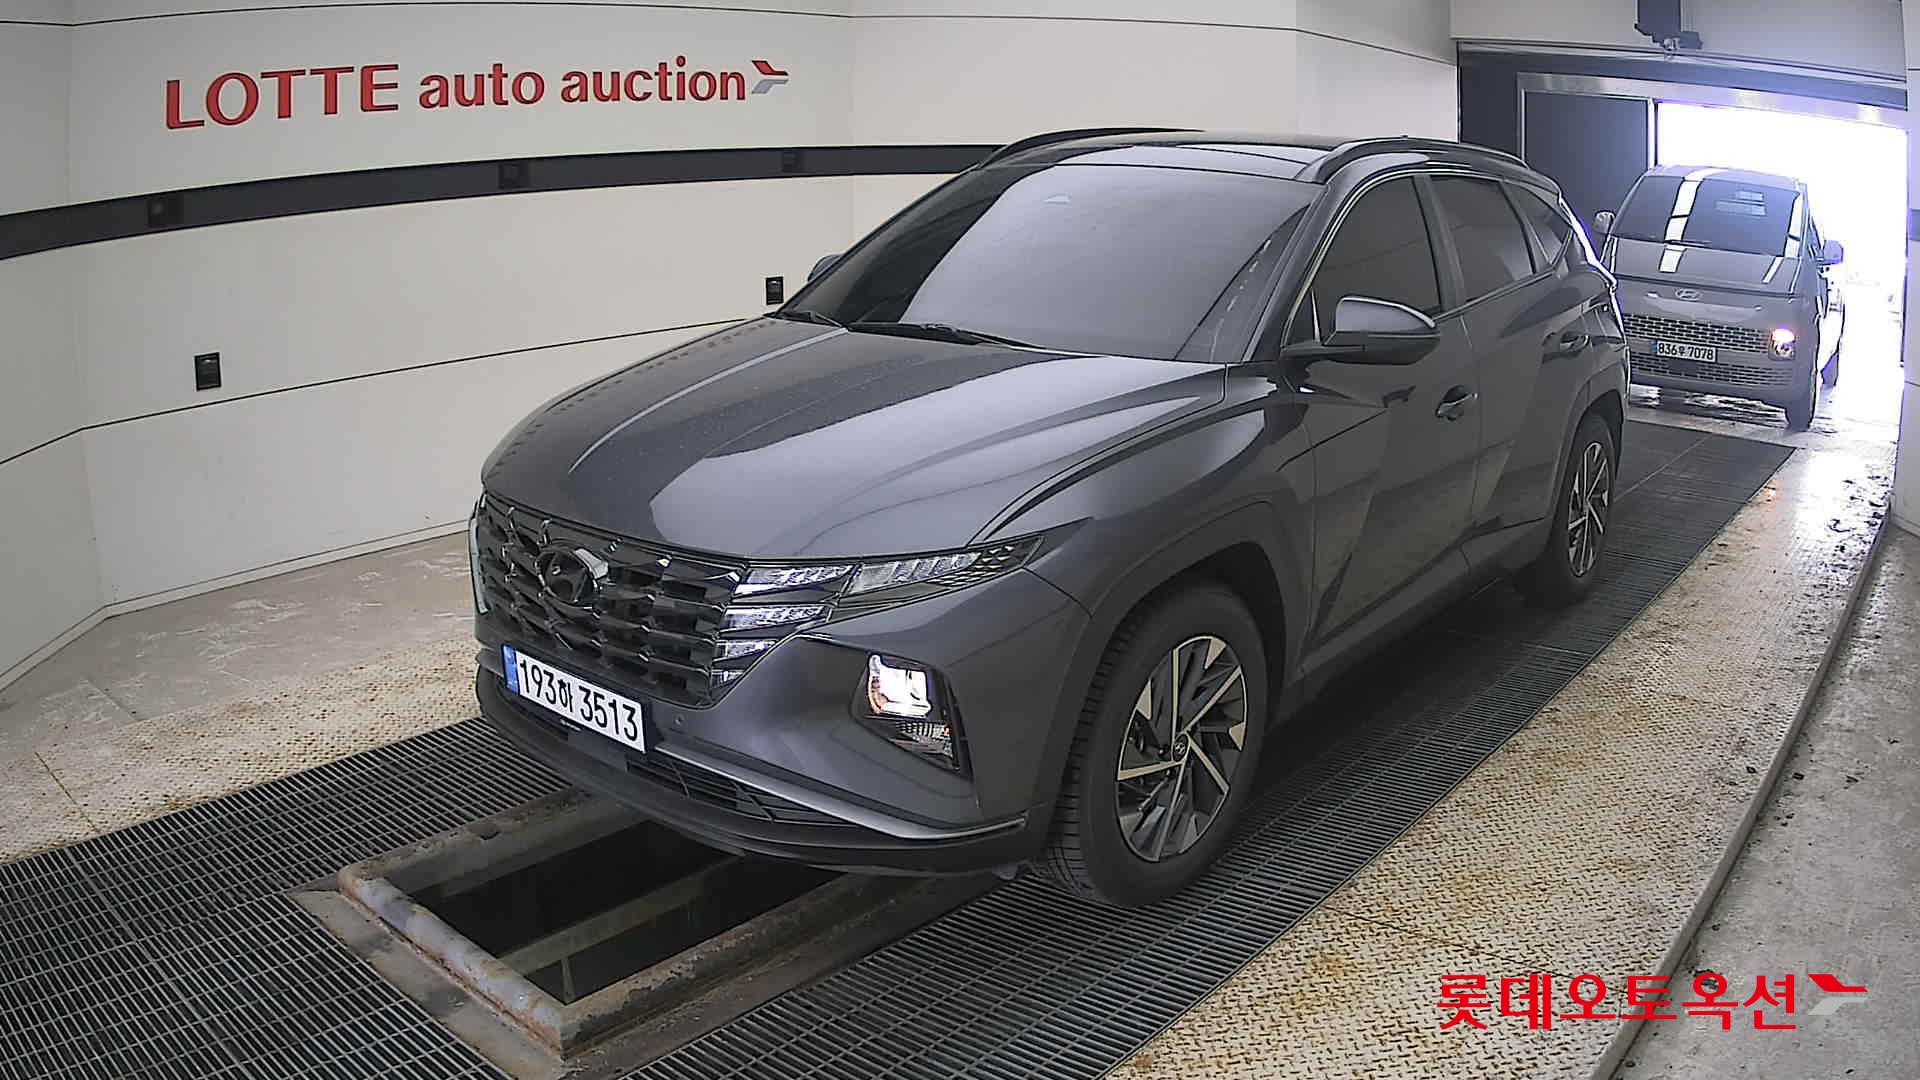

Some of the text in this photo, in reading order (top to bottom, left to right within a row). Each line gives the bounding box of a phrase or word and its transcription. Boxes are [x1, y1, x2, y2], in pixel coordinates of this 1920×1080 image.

[166, 55, 747, 130] LOTTE auto auction
[1687, 346, 1714, 361] 7078
[519, 659, 638, 742] 193하 3513
